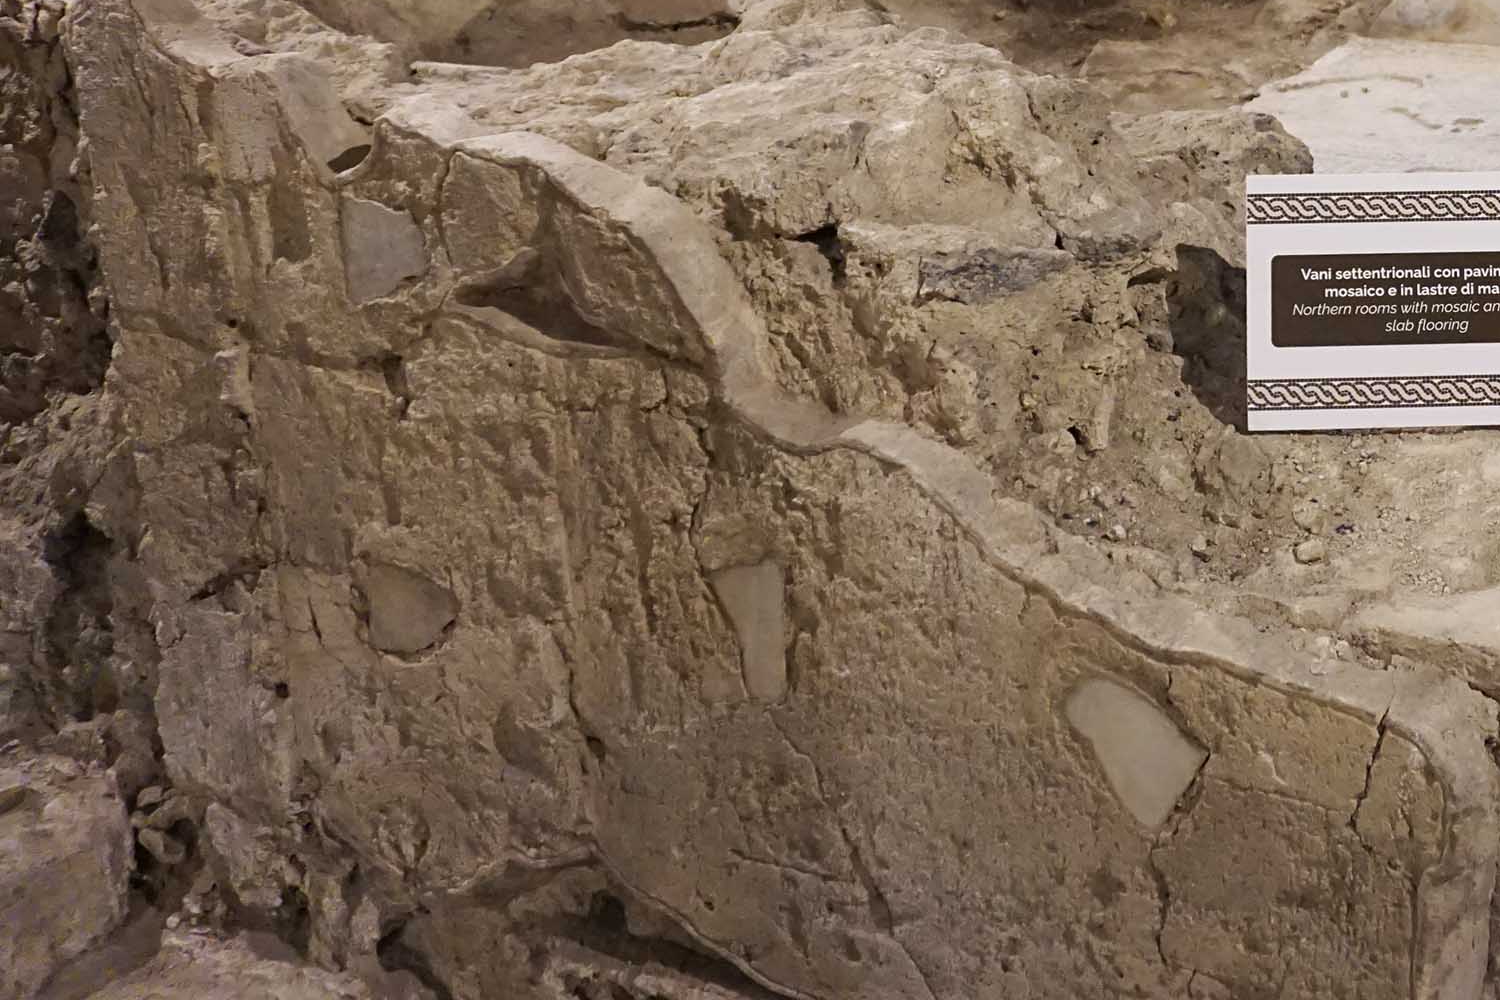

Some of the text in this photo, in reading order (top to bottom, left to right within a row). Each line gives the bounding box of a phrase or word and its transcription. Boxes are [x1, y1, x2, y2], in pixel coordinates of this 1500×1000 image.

[1300, 268, 1331, 281] Vani
[1335, 266, 1431, 280] settentrionali
[1433, 268, 1461, 279] con
[1324, 285, 1385, 297] mosaico
[1387, 287, 1398, 297] e
[1400, 284, 1414, 297] in
[1416, 283, 1458, 296] lastre
[1460, 282, 1475, 295] di
[1292, 303, 1352, 316] Northern
[1354, 304, 1398, 315] rooms
[1400, 300, 1428, 314] with
[1431, 300, 1481, 313] mosaic
[1384, 318, 1469, 335] slab flooring
